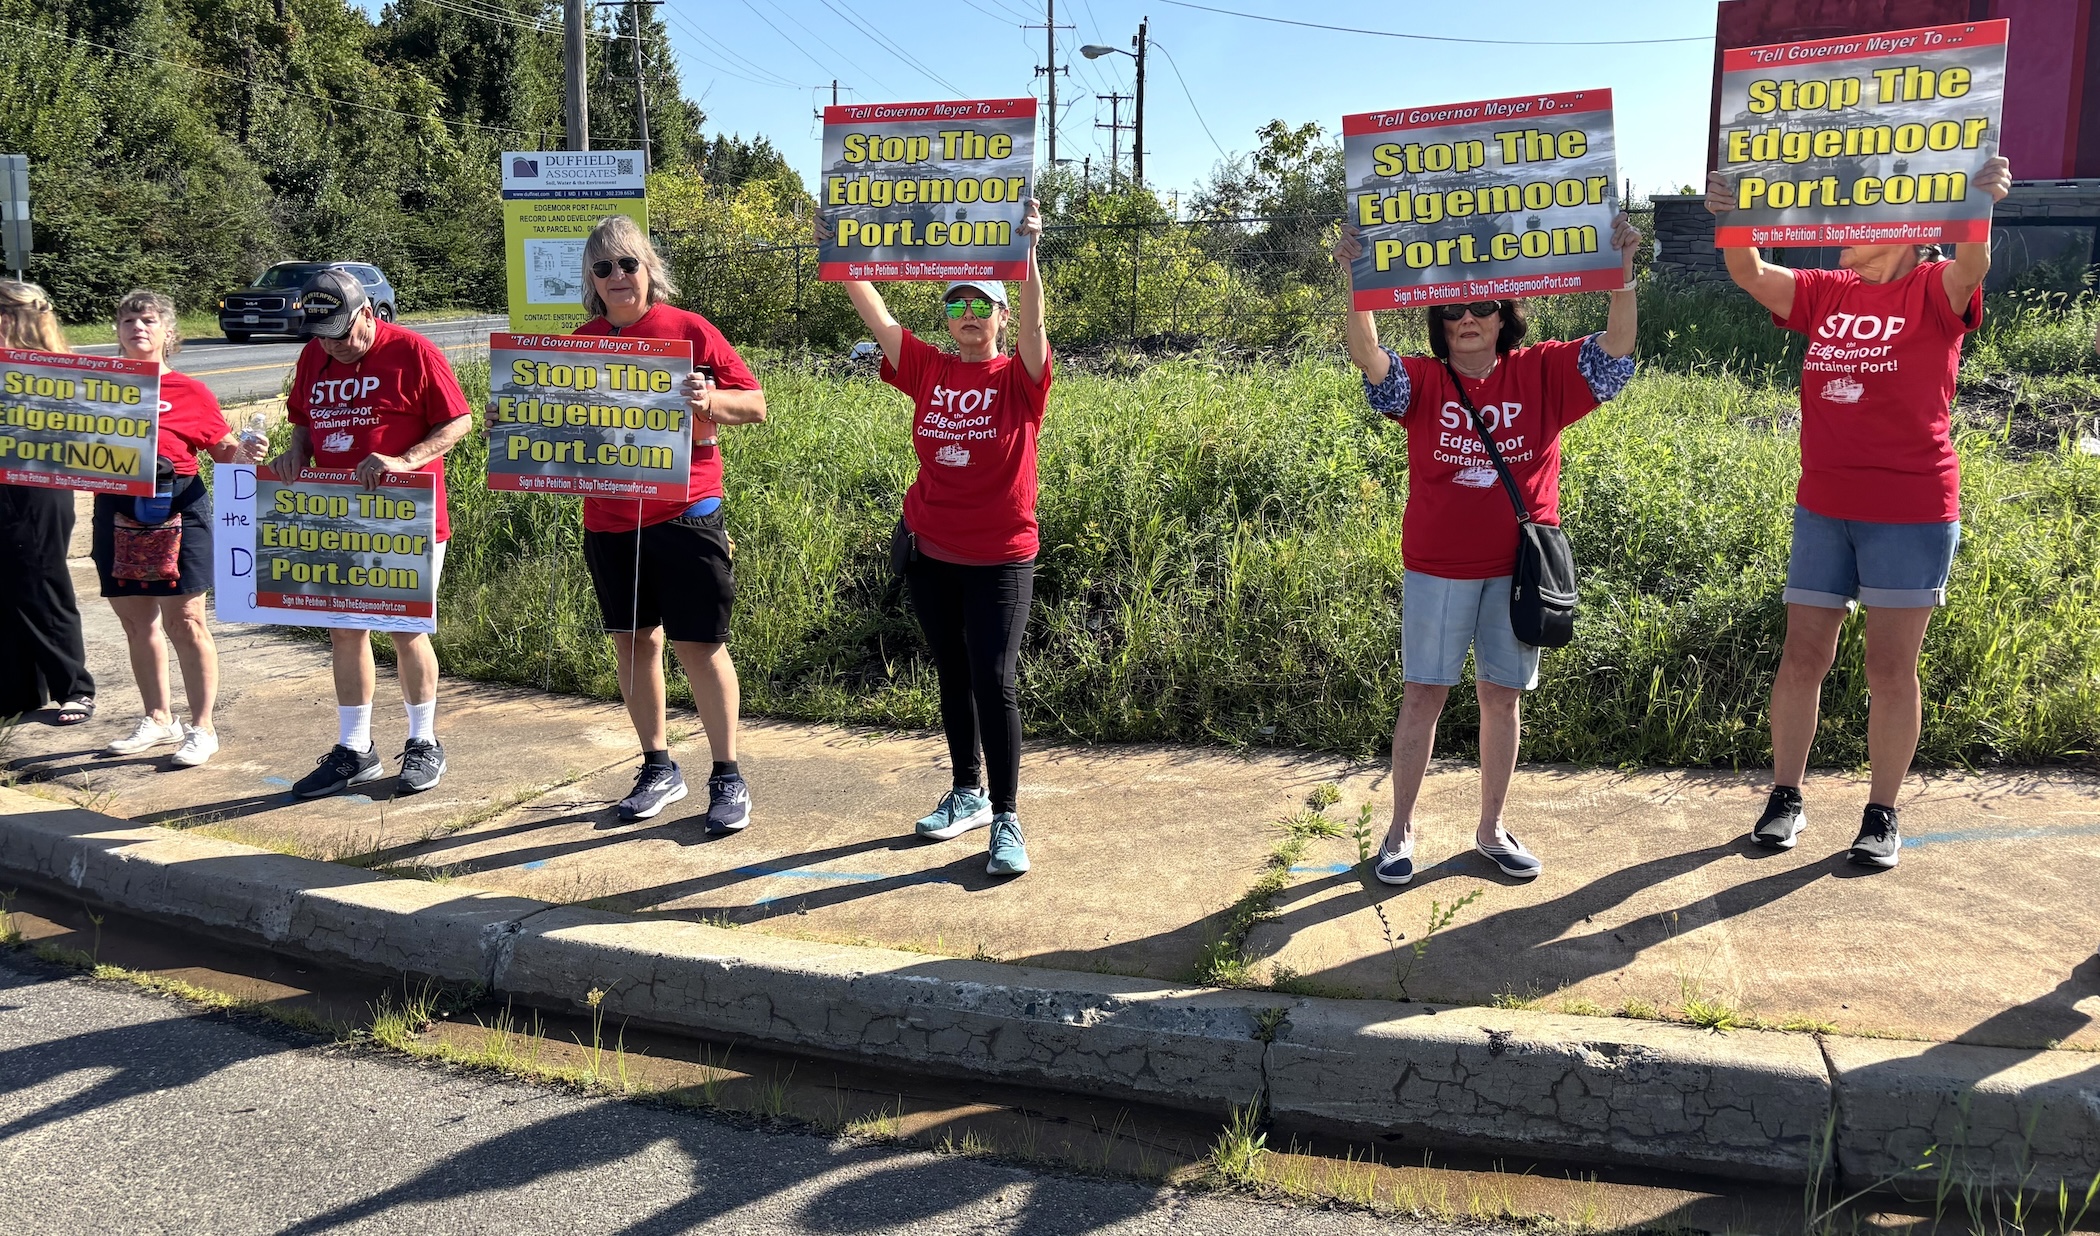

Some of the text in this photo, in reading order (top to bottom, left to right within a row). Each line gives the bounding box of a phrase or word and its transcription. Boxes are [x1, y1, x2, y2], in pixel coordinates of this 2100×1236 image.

[1788, 40, 1861, 60] Governor
[1865, 33, 1917, 53] Meyer
[1923, 31, 1943, 45] To
[1748, 65, 1972, 114] Stop The
[874, 104, 930, 118] Governor
[933, 103, 972, 118] Meyer
[976, 102, 991, 114] To
[1409, 105, 1480, 124] Governor
[1484, 98, 1533, 119] Meyer
[1538, 97, 1556, 110] To
[844, 130, 1013, 164] Stop The
[1373, 128, 1588, 178] Stop The
[1727, 116, 1989, 164] Edgemoor
[545, 155, 616, 166] DUFFIELD
[545, 169, 617, 179] ASSOCIATES
[828, 176, 1026, 208] Edgemoor
[1357, 175, 1609, 227] Edgemoor
[1738, 171, 1967, 210] Port.com
[519, 215, 547, 223] RECORD
[567, 214, 609, 222] DEVELOPME
[534, 204, 571, 212] EDGEMOOR
[591, 203, 618, 211] FACILITY
[547, 225, 572, 233] PARCEL
[837, 219, 1011, 247] Port.com
[1752, 227, 1769, 243] Sign
[1770, 227, 1783, 241] the
[1785, 226, 1816, 241] Petition
[1826, 223, 1942, 242] StopTheEdgemoorPort.com
[1374, 224, 1599, 272] Port.com
[849, 263, 863, 278] Sign
[863, 264, 874, 275] the
[875, 263, 899, 276] Petition
[905, 263, 994, 278] StopTheEdgemoorPort.com
[1393, 288, 1412, 306] Sign
[1413, 287, 1427, 301] the
[1428, 284, 1461, 298] Petition
[1470, 275, 1582, 297] StopTheEdgemoorPort.com
[1818, 312, 1906, 341] STOP
[541, 337, 595, 349] Governor
[598, 339, 633, 352] Meyer
[637, 340, 650, 352] To
[1808, 341, 1892, 360] Edgemoor
[30, 354, 75, 365] Governor
[77, 357, 108, 369] Meyer
[112, 360, 124, 370] To
[1860, 360, 1898, 373] Port!
[4, 371, 141, 405] Stop The
[512, 359, 672, 393] Stop The
[309, 376, 380, 404] STOP
[310, 406, 372, 419] Edgemoor
[314, 416, 380, 430] ontainer Port!
[498, 396, 685, 432] Edgemoor
[923, 412, 992, 430] Edgemoor
[1439, 401, 1522, 434] STOP
[917, 425, 997, 440] Container Port!
[0, 436, 63, 463] Port
[67, 443, 136, 474] NOW
[507, 435, 674, 470] Port.com
[1433, 449, 1494, 467] Containe
[300, 469, 347, 481] Governor
[385, 474, 398, 484] To
[519, 475, 533, 489] Sign
[534, 477, 544, 487] the
[546, 477, 571, 489] Petition
[578, 480, 658, 495] StopTheEdgemoorPort.com
[274, 489, 416, 521] Stop The
[222, 512, 250, 527] the
[262, 523, 428, 555] Edgemoor
[271, 558, 419, 590] Port.com
[282, 594, 406, 612] Sign the Petition StopTheEdgemoorPort.com
